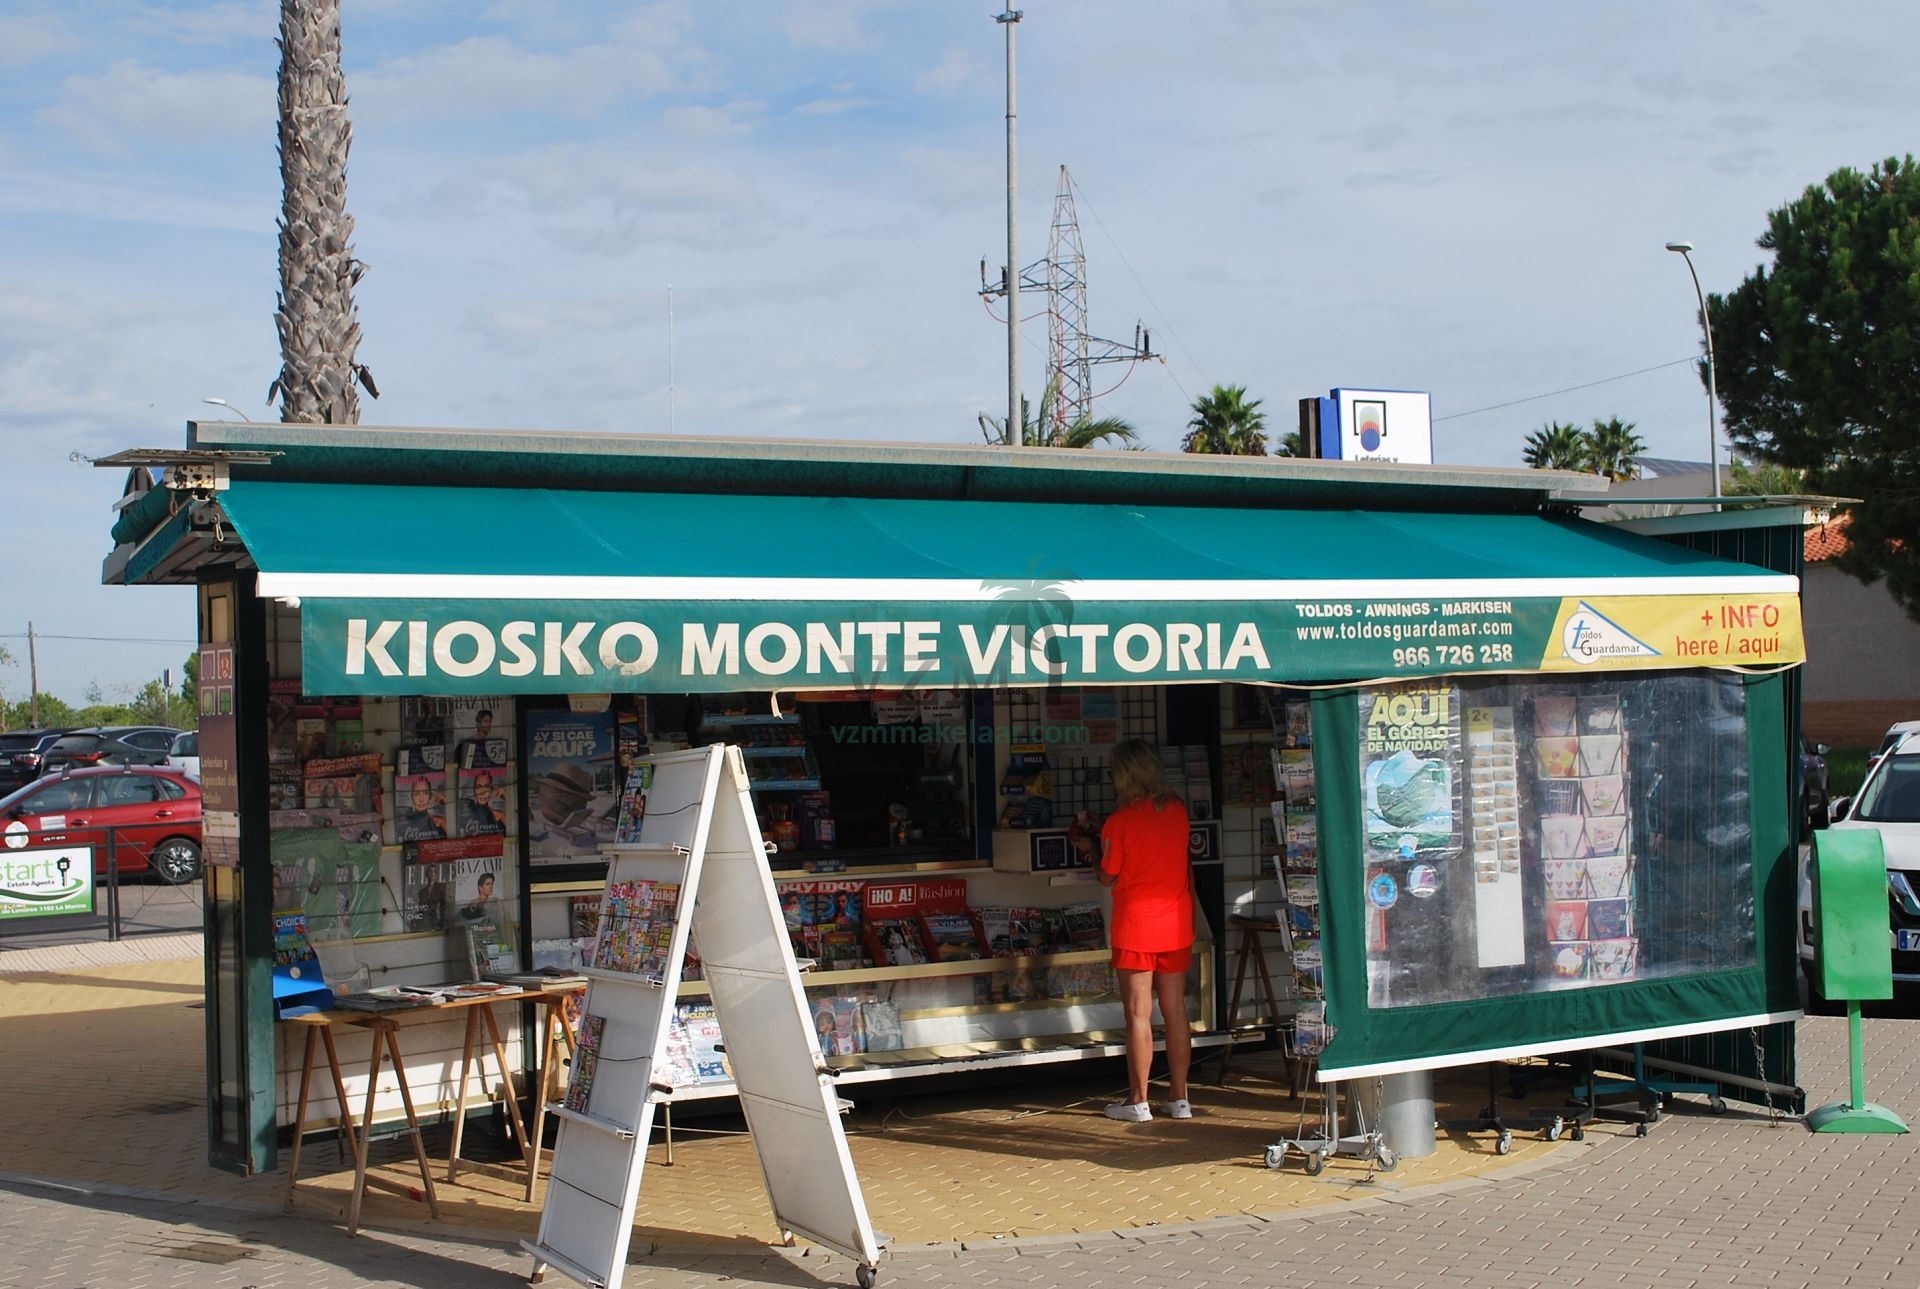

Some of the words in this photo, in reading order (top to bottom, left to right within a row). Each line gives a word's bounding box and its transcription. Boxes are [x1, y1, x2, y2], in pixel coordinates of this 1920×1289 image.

[1295, 604, 1354, 618] TOLDOS
[1364, 602, 1431, 617] AWNINGS
[1442, 601, 1512, 616] MARKISEN
[1720, 603, 1780, 630] INFO
[1296, 620, 1513, 641] www.toldosguardamar.com
[345, 618, 659, 678] KIOSKO
[680, 622, 941, 676] MONTE
[958, 622, 1271, 675] VICTORIA
[1580, 639, 1641, 656] Guardamar
[1676, 636, 1719, 657] here
[1738, 631, 1780, 659] aquí
[1392, 648, 1431, 668] 966
[1436, 645, 1475, 666] 726
[1479, 643, 1514, 664] 258
[1367, 687, 1451, 727] AQUÍ
[534, 731, 550, 742] ¿Y
[552, 731, 566, 741] SI
[567, 730, 594, 741] CAE
[1367, 726, 1386, 741] EL
[1388, 726, 1450, 741] GORDO
[1367, 740, 1384, 752] DE
[1384, 740, 1449, 753] NAVIDAD?
[456, 855, 503, 875] BAZAAR
[30, 879, 55, 888] Agents
[818, 880, 867, 893] muy
[275, 915, 306, 928] CHOICE
